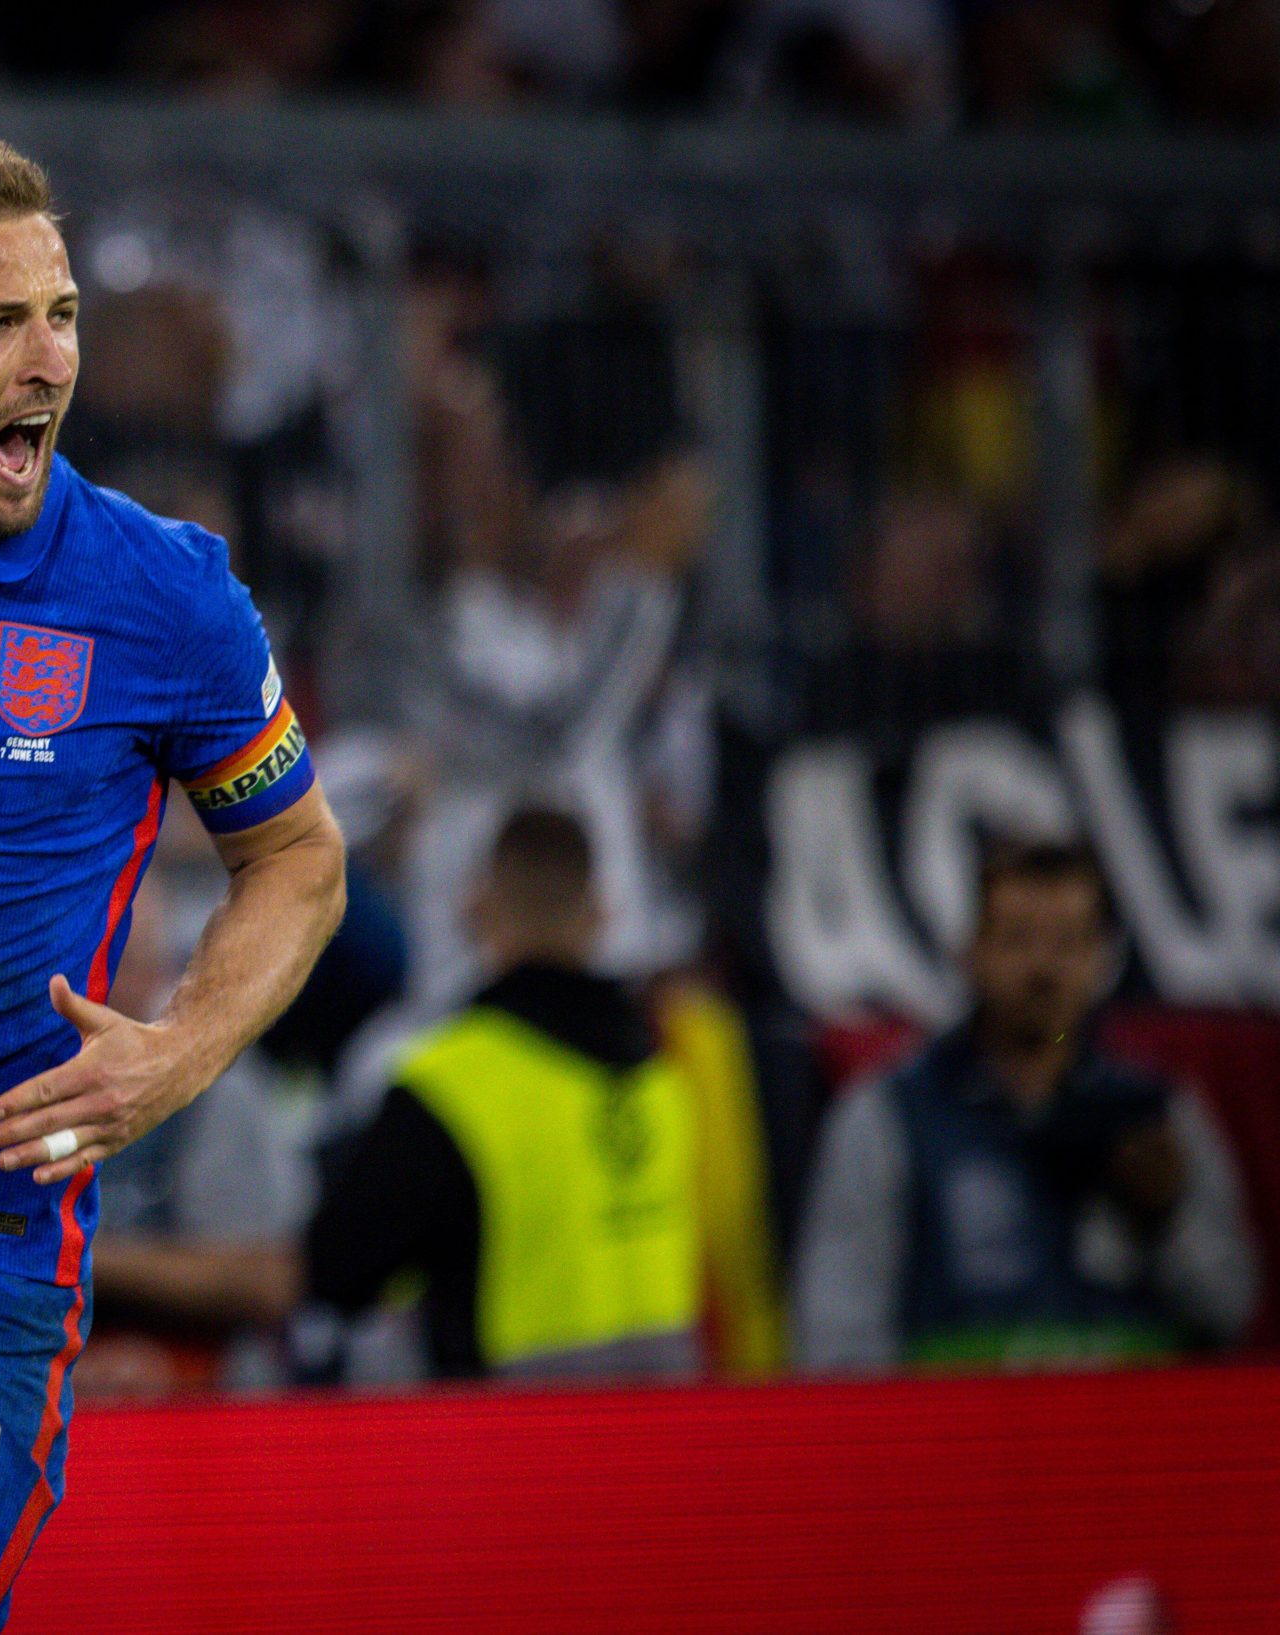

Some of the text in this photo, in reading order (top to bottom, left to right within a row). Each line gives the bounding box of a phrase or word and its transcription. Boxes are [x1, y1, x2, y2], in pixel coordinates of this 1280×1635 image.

[6, 736, 51, 750] GERMANY
[0, 746, 56, 763] 7 JUNE 2022
